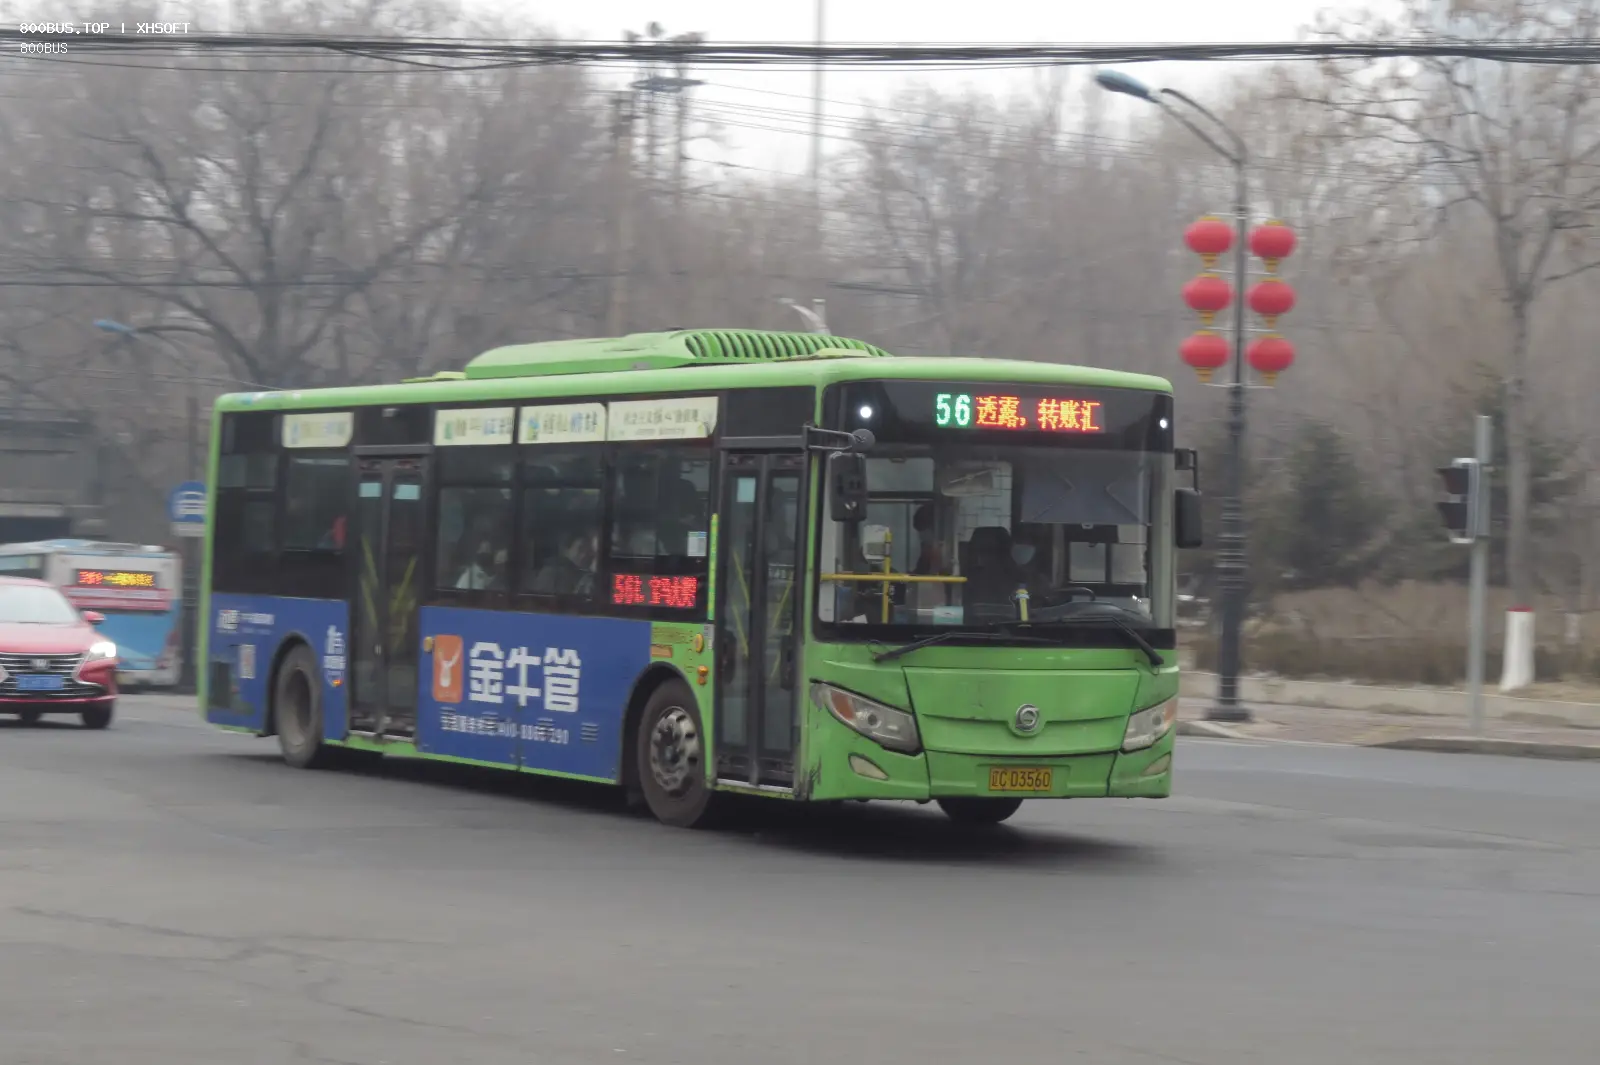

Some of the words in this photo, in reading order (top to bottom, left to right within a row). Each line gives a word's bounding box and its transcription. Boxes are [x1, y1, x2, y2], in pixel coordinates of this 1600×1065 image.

[936, 393, 971, 427] 56
[469, 641, 582, 713] 金牛管
